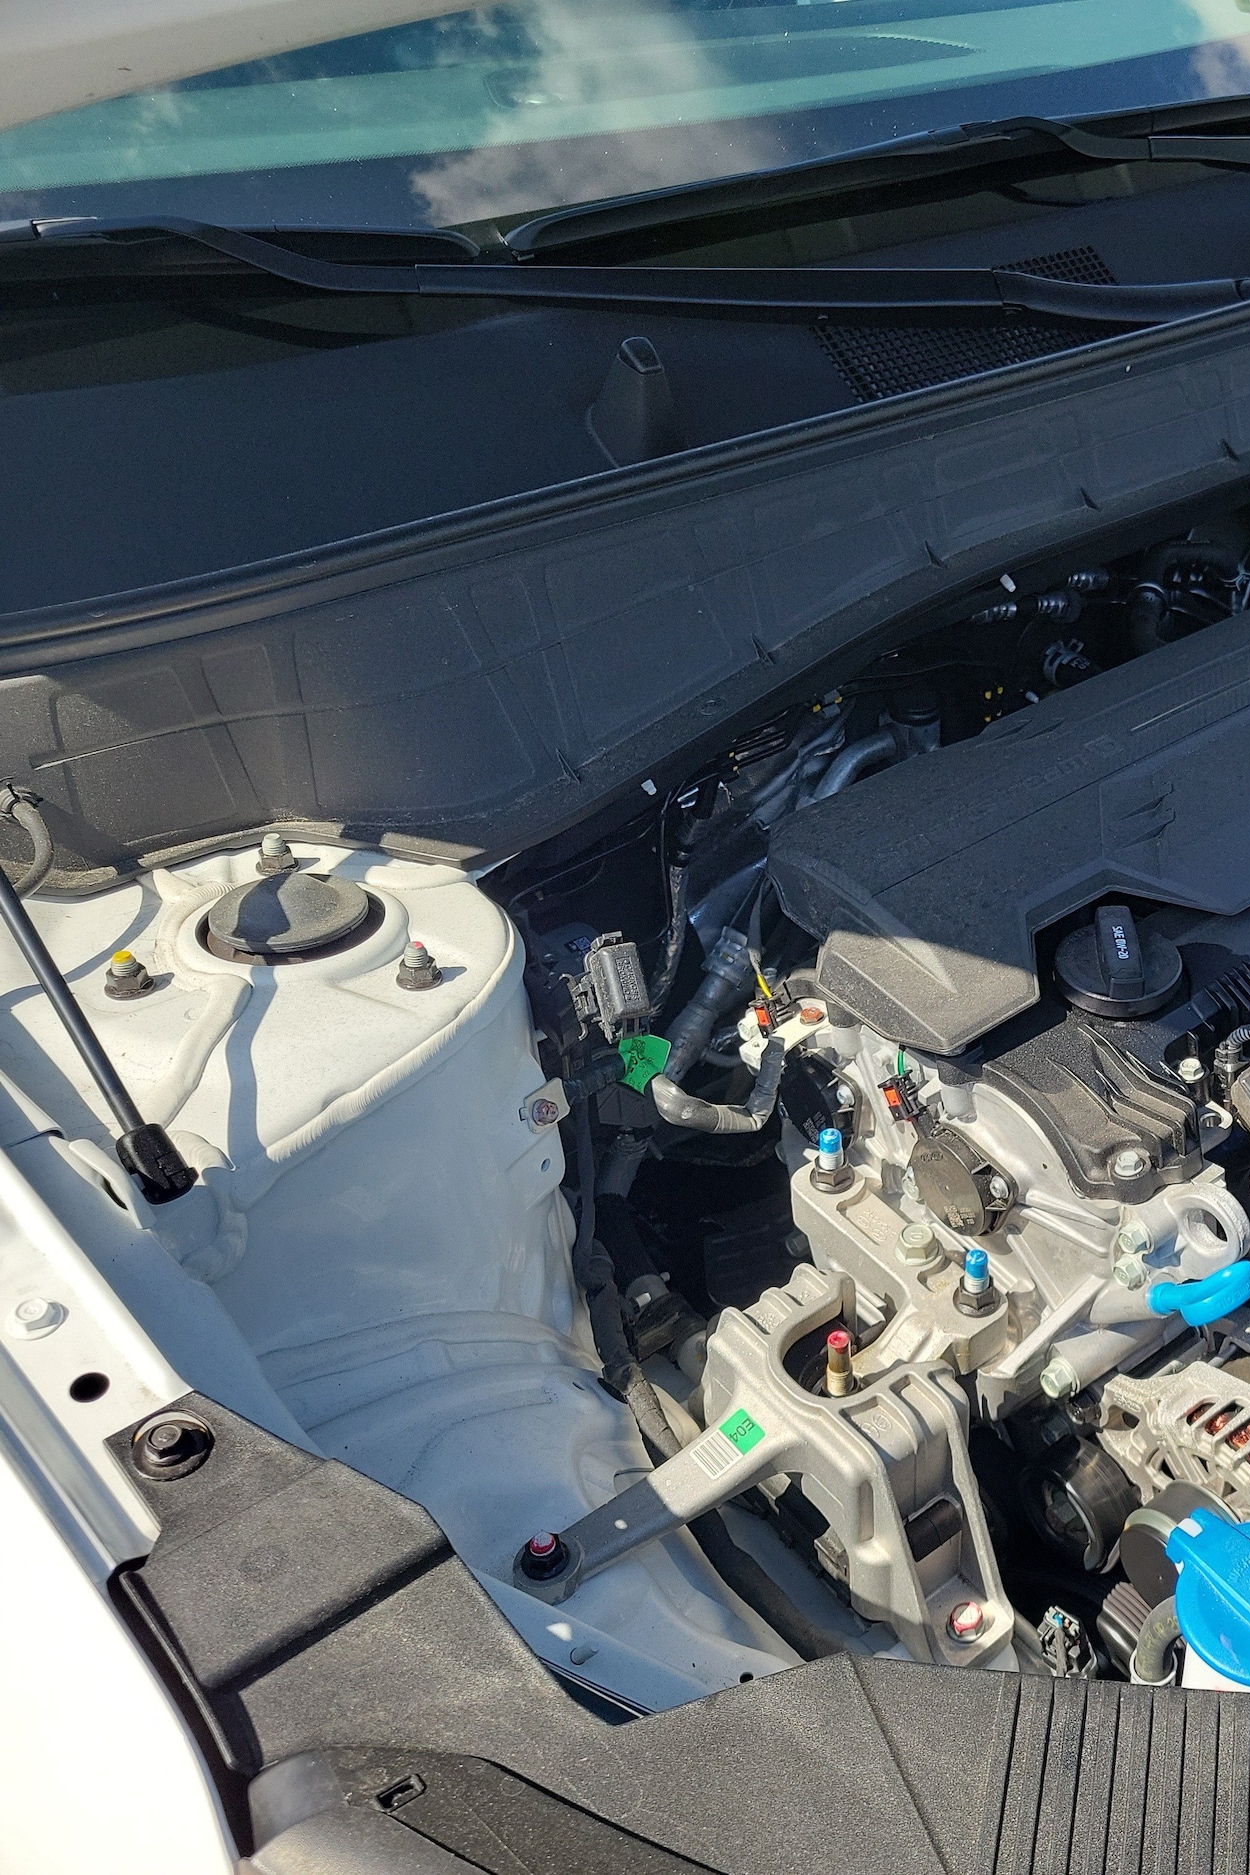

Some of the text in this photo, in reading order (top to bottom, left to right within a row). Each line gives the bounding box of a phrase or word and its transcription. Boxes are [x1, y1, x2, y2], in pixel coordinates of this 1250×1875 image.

[1112, 926, 1129, 960] SAE 0W-20
[729, 1417, 756, 1443] E04
